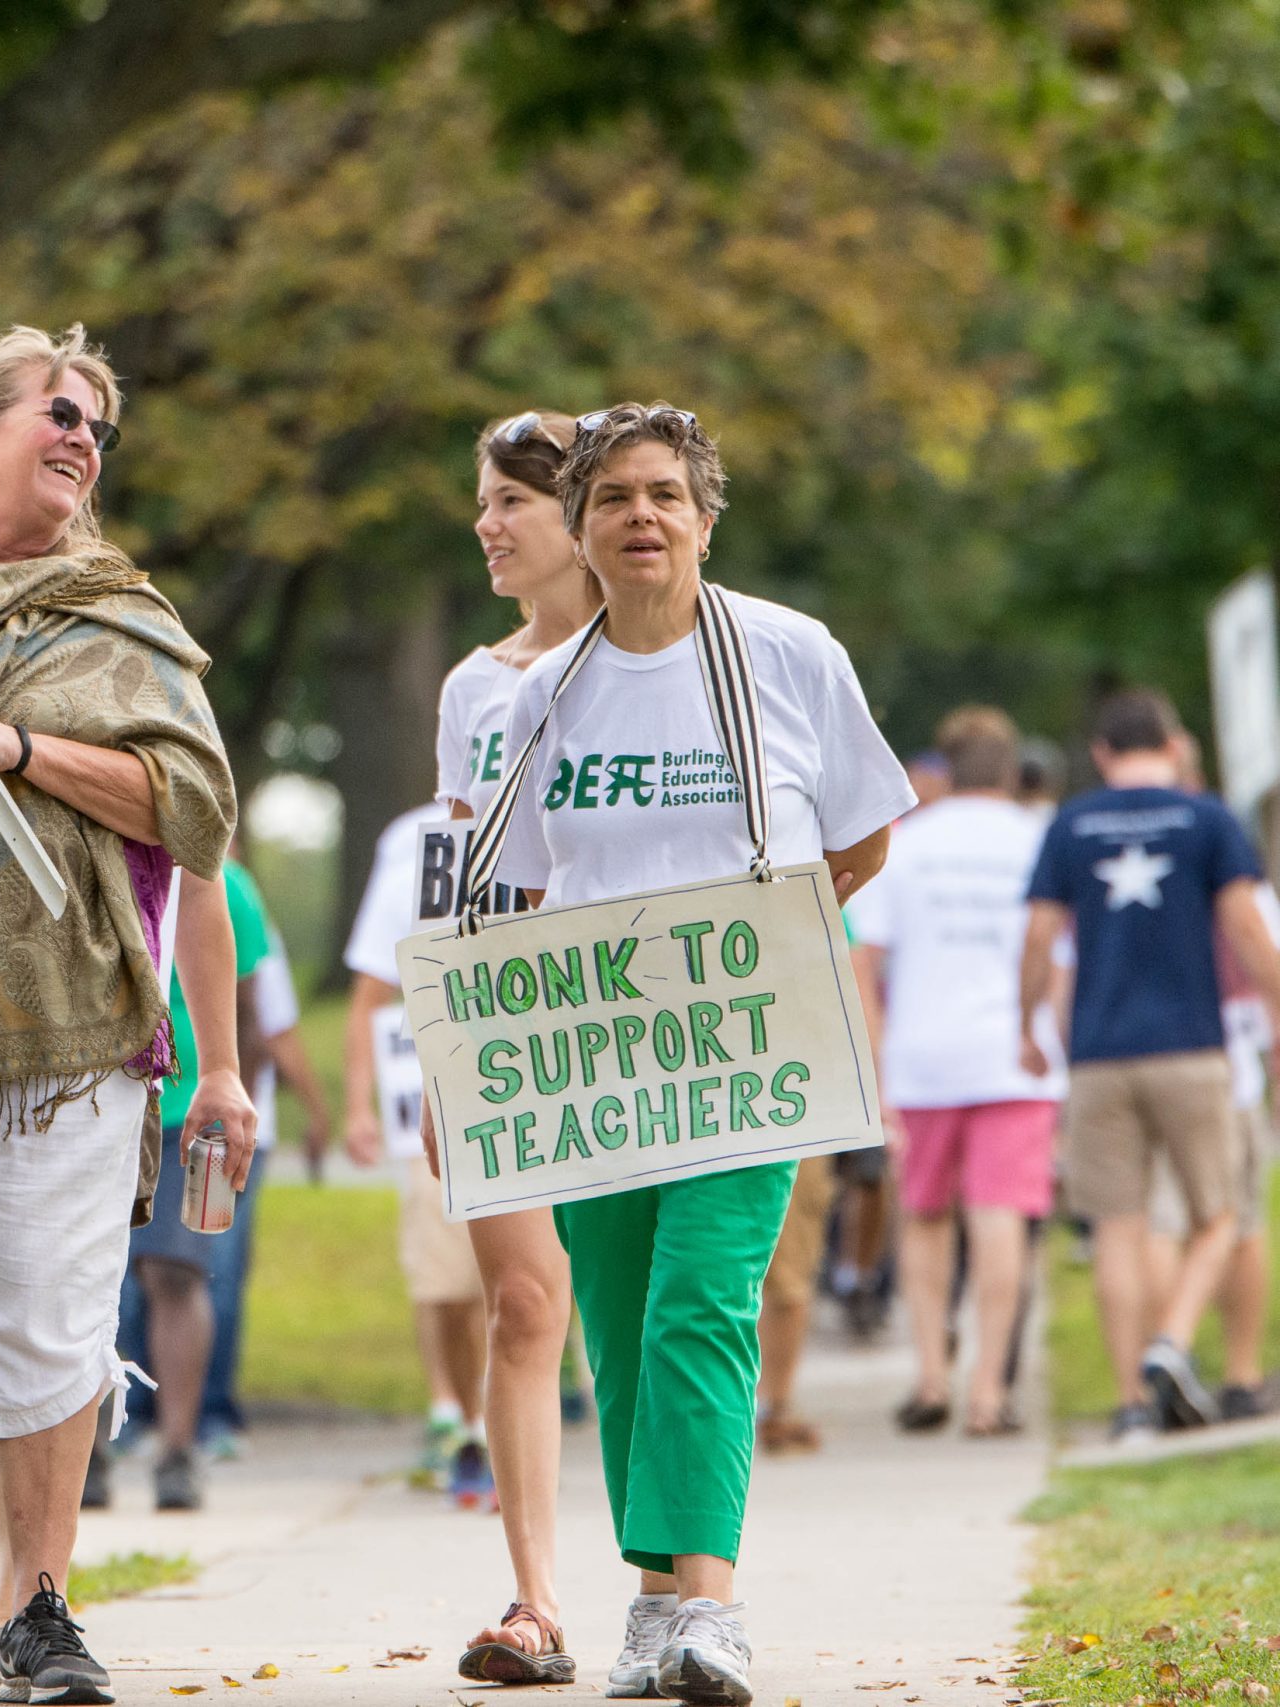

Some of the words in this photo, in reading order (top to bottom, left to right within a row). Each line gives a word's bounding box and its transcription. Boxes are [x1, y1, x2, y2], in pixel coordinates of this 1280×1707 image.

[661, 769, 740, 787] Educatio
[662, 748, 730, 768] Burling
[444, 937, 644, 1023] HONK
[670, 921, 759, 984] TO
[478, 993, 775, 1104] SUPPORT
[464, 1062, 811, 1179] TEACHERS
